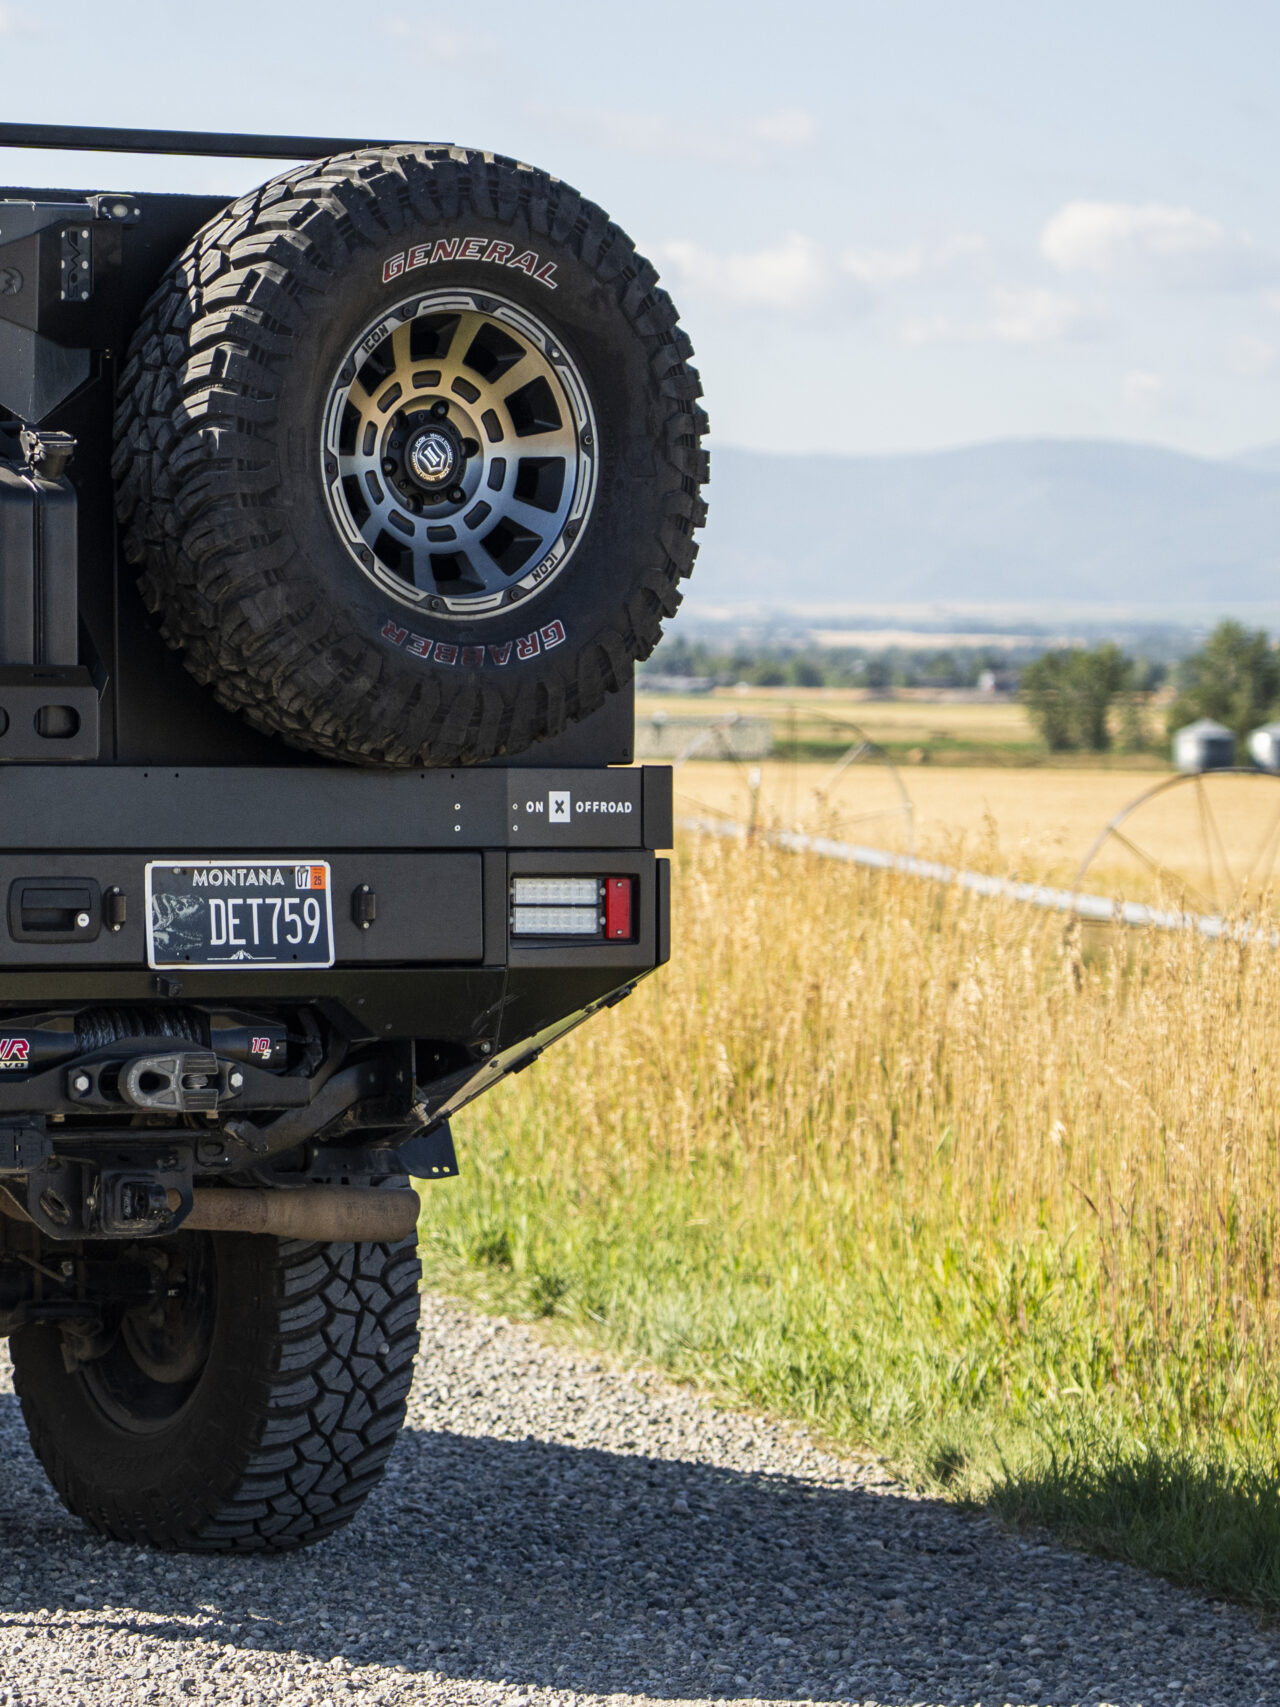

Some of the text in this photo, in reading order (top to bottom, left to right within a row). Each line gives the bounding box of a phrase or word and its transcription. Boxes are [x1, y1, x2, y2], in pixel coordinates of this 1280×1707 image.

[382, 237, 558, 290] GENERAL
[361, 324, 389, 354] ICON
[531, 552, 558, 582] ICON
[380, 619, 566, 666] GRABBER
[526, 801, 544, 813] ON
[575, 801, 633, 813] OFFROAD
[192, 868, 285, 887] MONTANA
[208, 897, 321, 945] DET759
